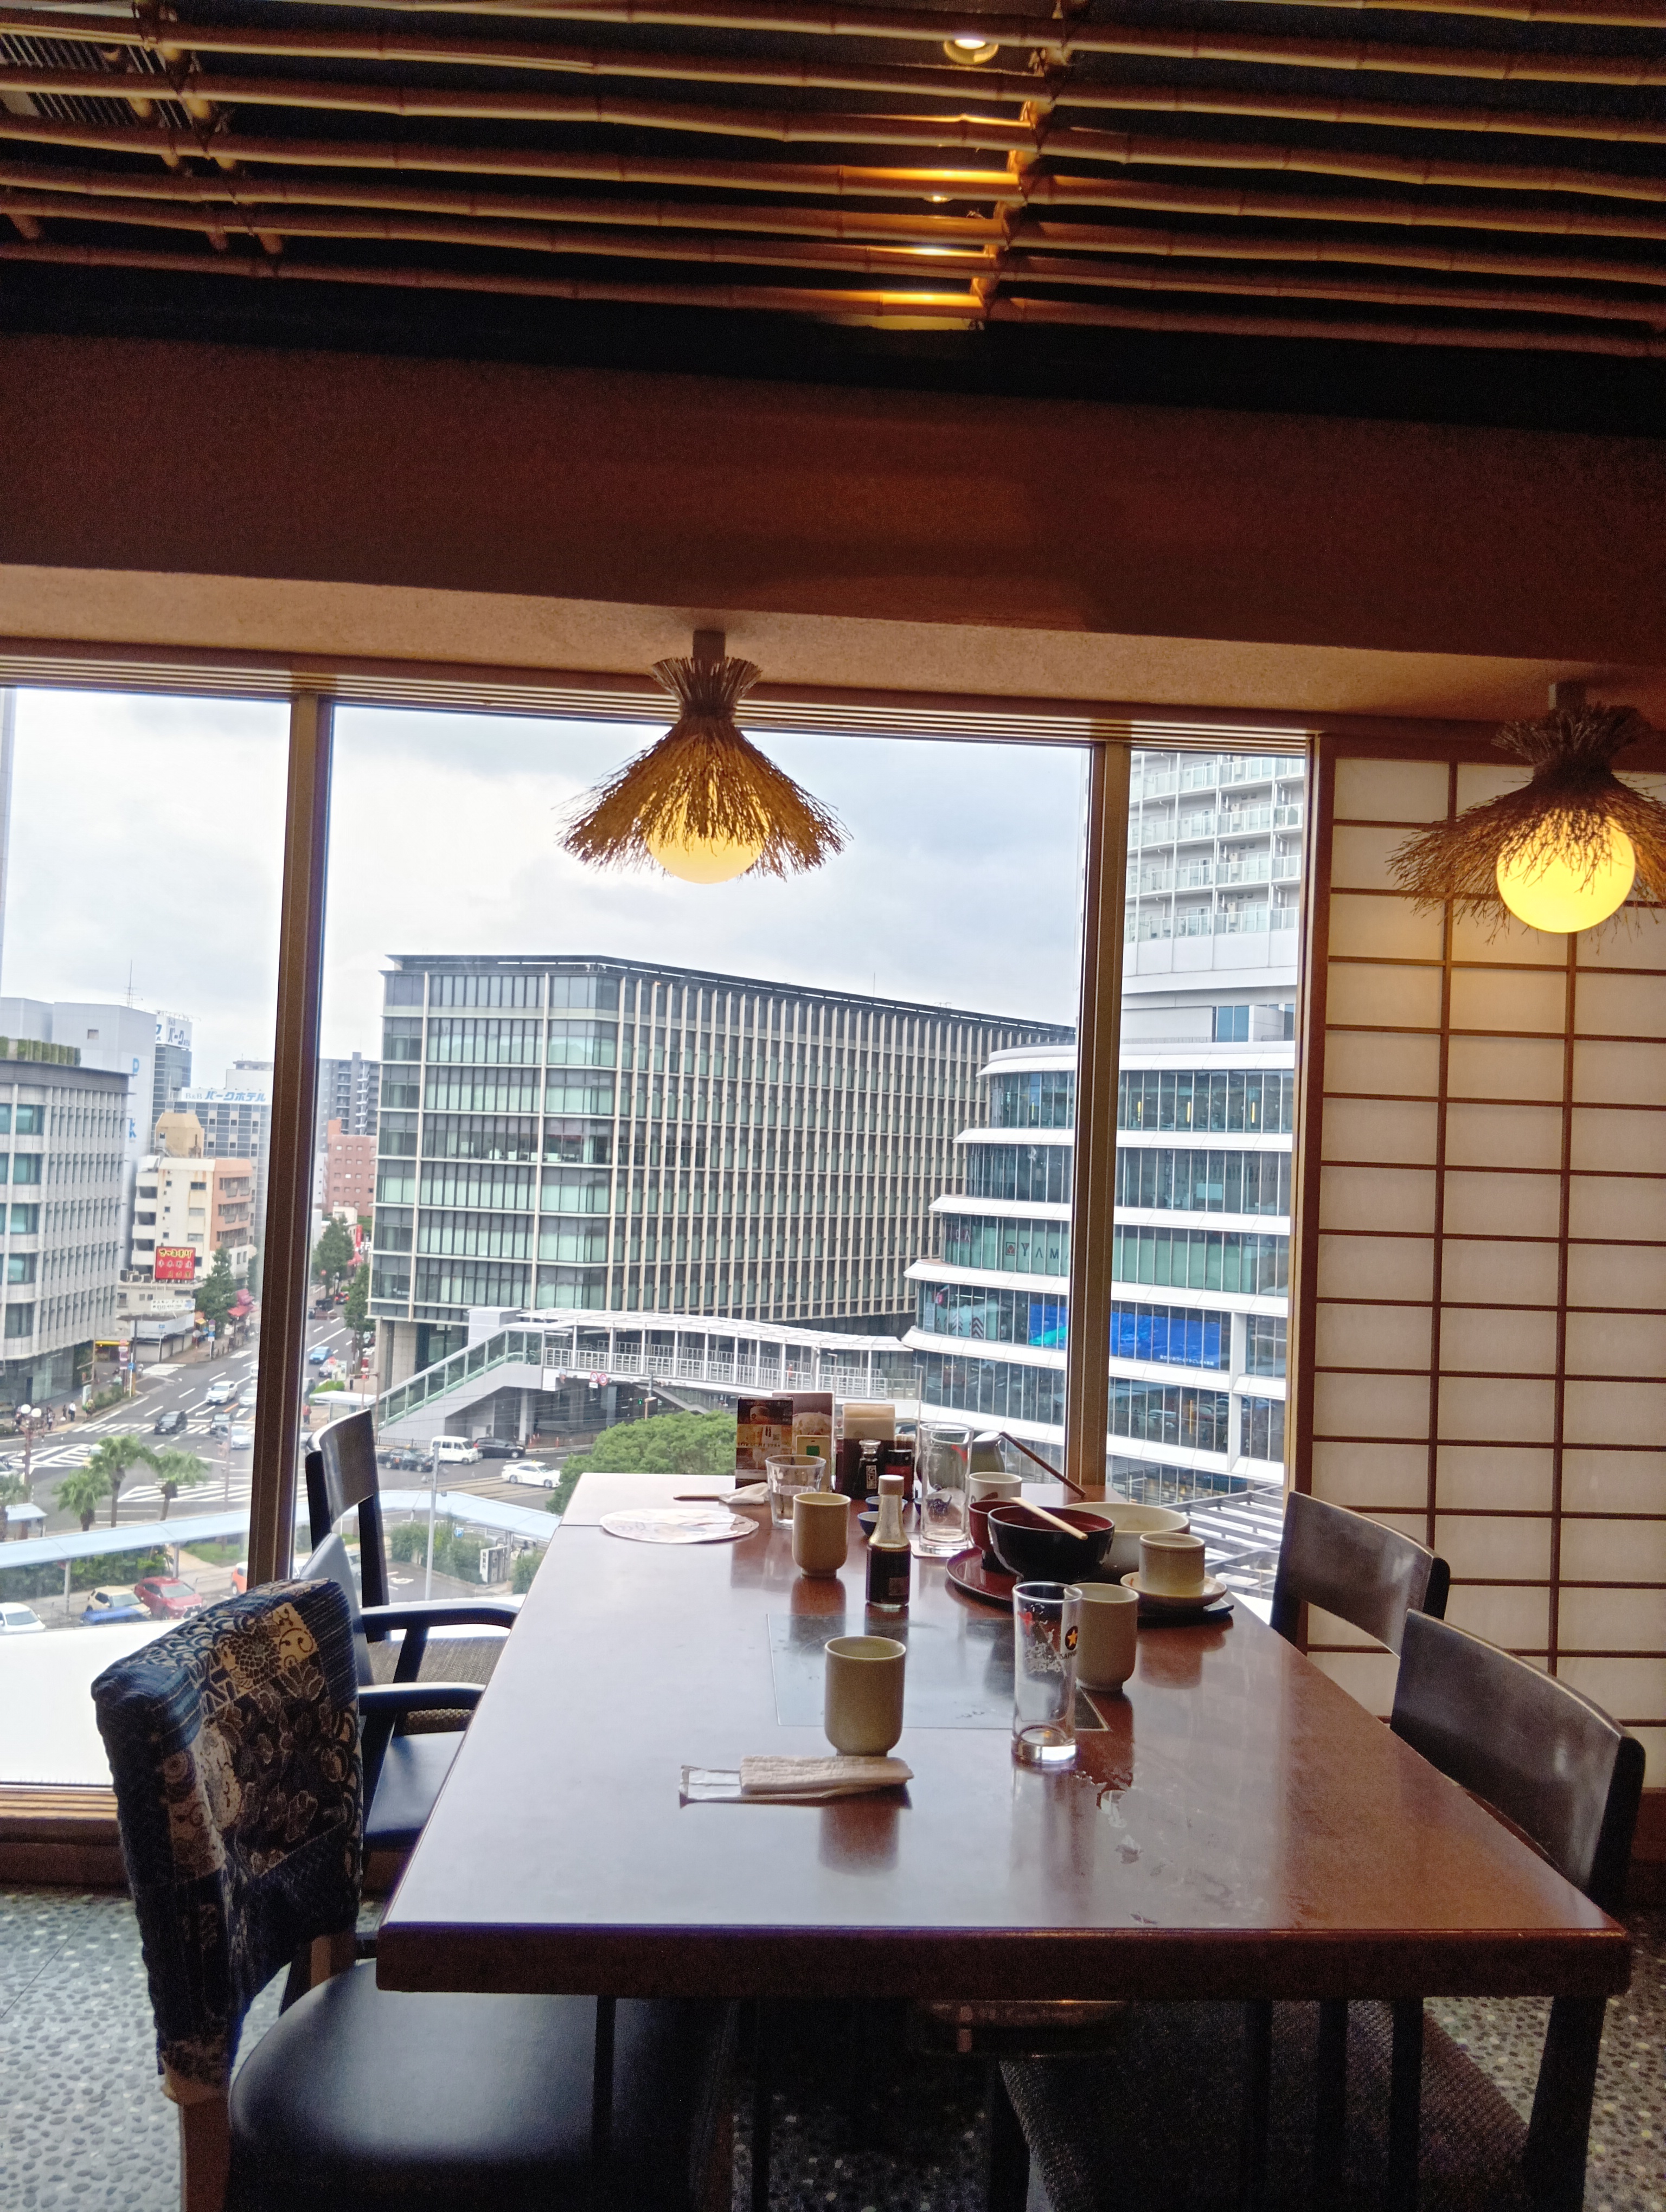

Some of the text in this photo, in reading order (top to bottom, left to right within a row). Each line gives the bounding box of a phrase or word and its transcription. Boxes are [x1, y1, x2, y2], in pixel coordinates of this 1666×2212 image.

[204, 1091, 266, 1102] パークホテル
[1021, 1243, 1069, 1259] YAM
